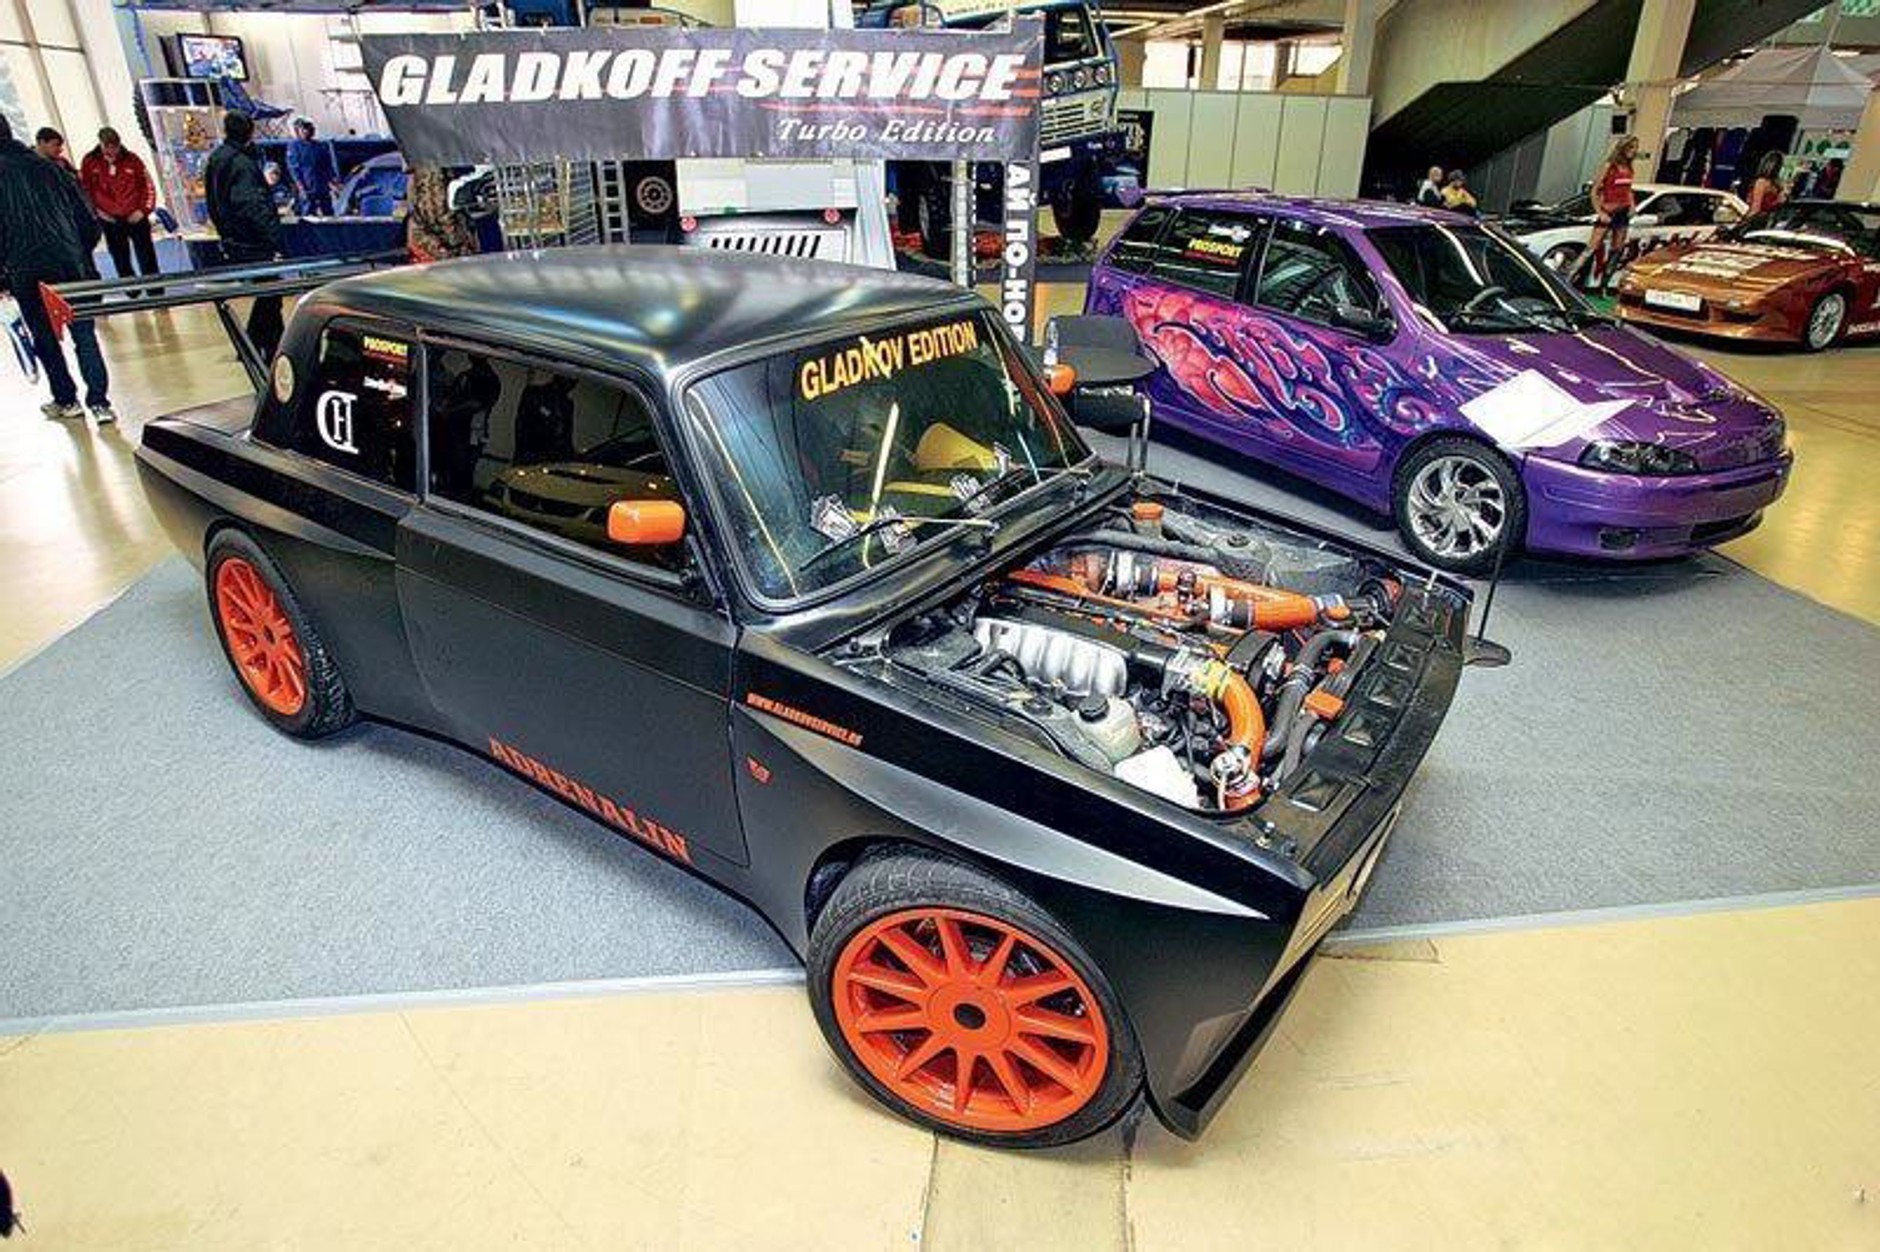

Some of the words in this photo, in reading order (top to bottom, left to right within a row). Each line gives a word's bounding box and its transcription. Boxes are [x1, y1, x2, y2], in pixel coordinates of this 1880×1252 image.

[380, 49, 732, 106] GLADKOFF
[736, 48, 1027, 100] SERVICE
[777, 118, 867, 141] Turbo
[880, 119, 995, 142] Edition
[801, 336, 903, 400] GLADKOV
[907, 321, 978, 366] EDITION
